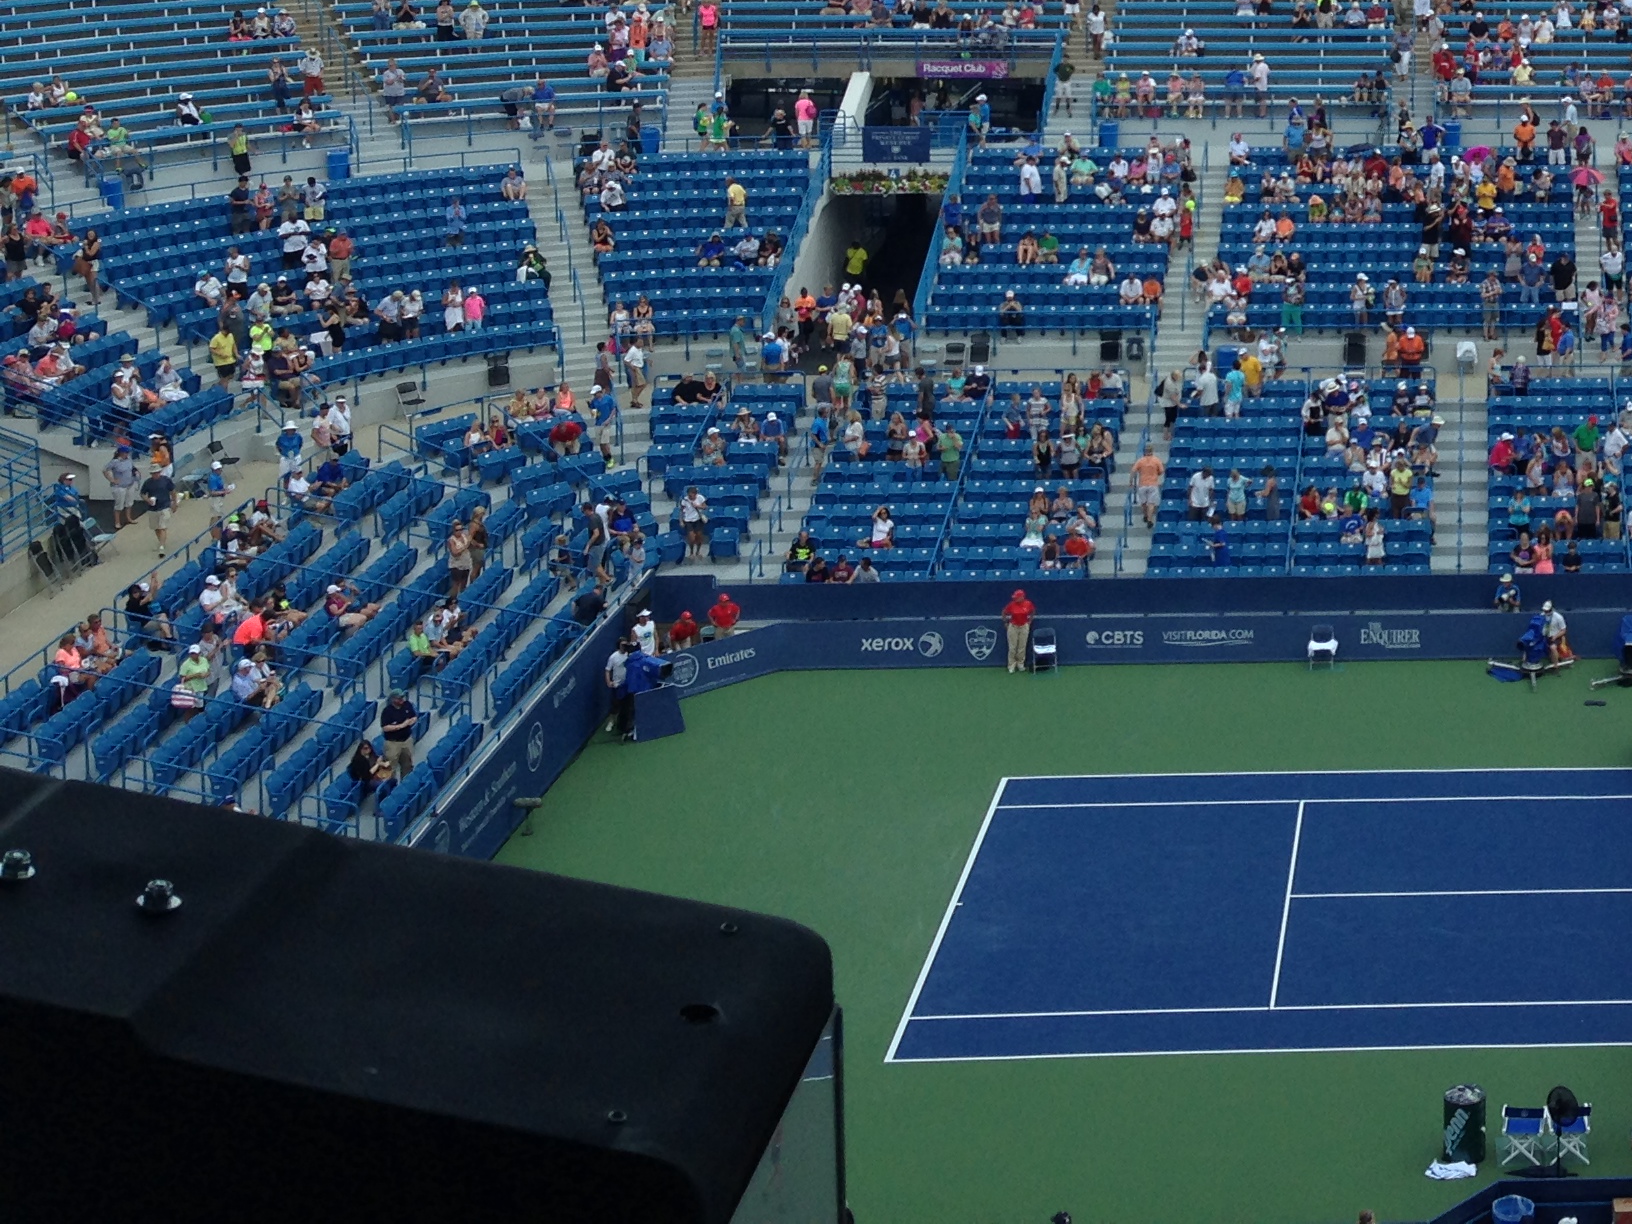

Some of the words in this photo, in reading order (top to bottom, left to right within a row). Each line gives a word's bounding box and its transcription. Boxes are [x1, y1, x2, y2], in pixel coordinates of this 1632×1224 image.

[923, 63, 962, 74] Racquet
[964, 63, 986, 73] Club
[860, 637, 914, 651] xerox
[1101, 631, 1144, 644] CBTS
[1360, 629, 1420, 645] ENQUIRER
[707, 647, 756, 669] Emirates
